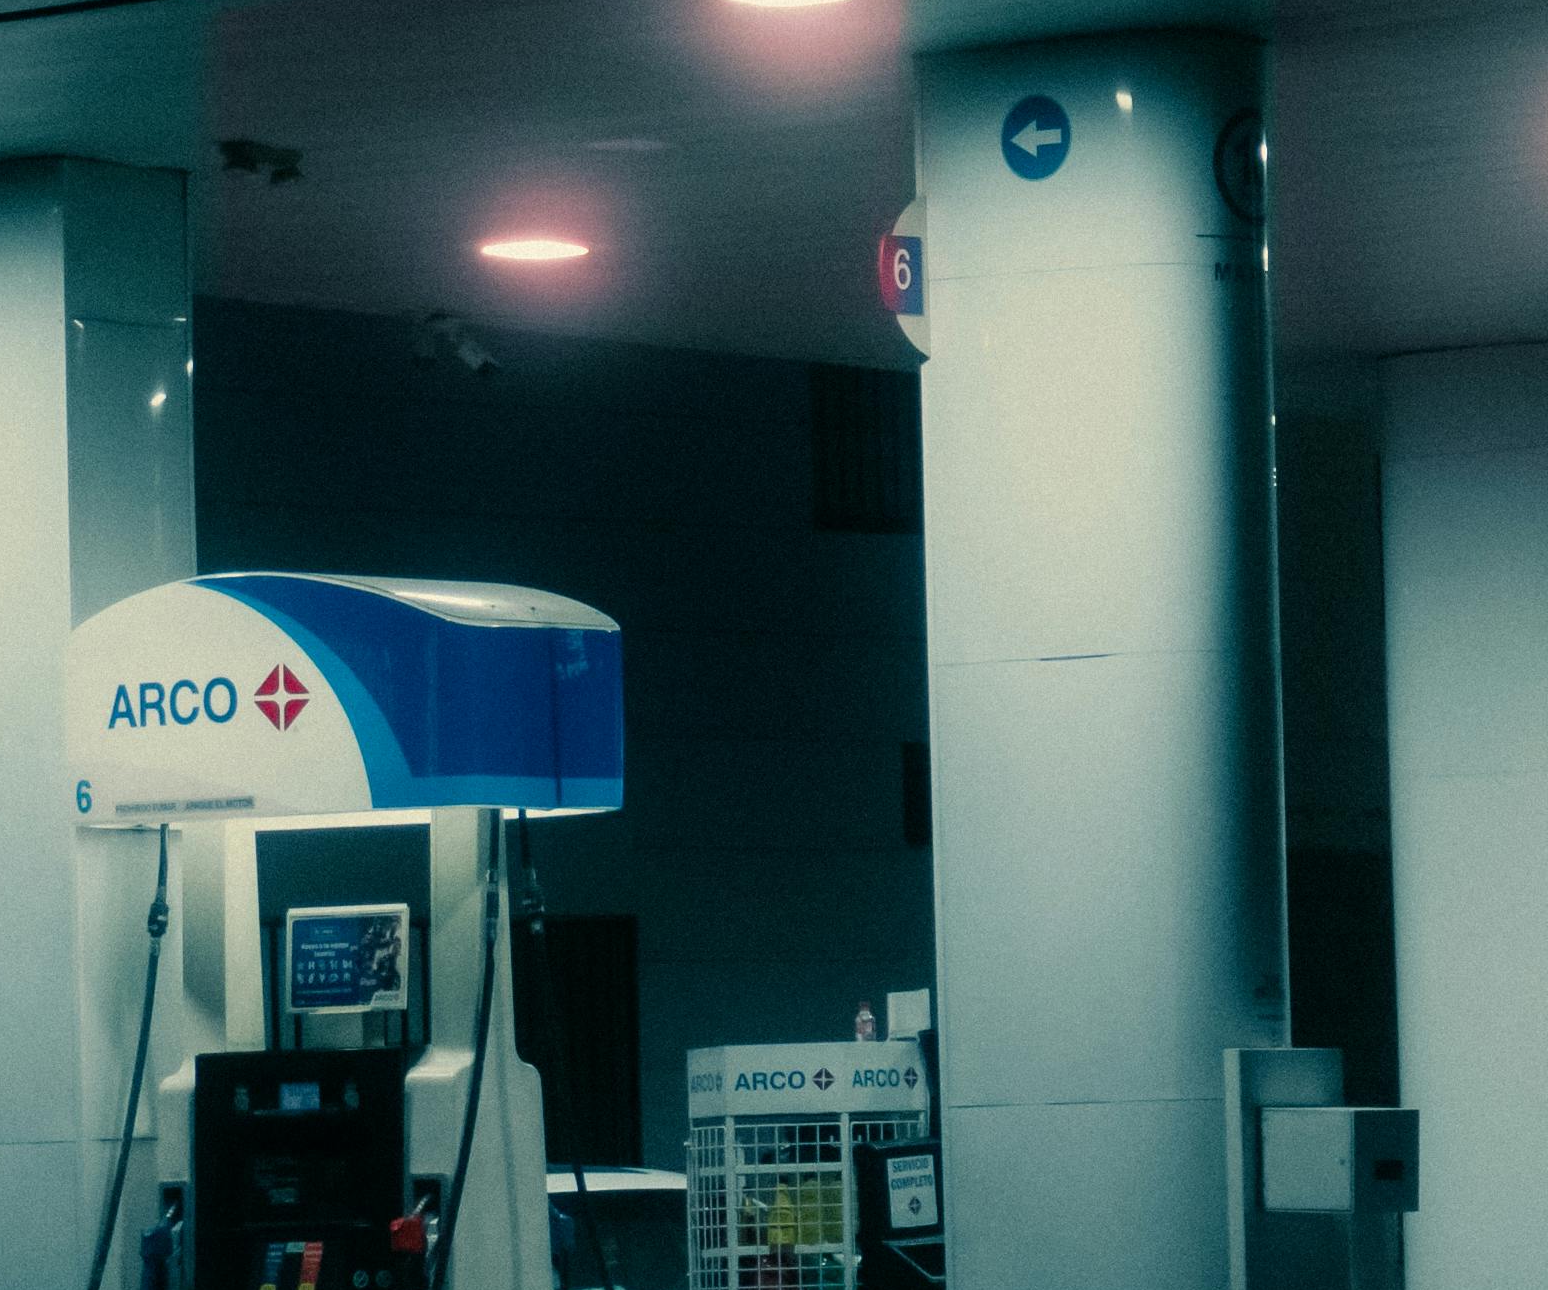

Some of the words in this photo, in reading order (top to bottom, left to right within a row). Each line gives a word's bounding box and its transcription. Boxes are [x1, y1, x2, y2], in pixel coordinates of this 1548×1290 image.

[892, 248, 912, 290] 6
[107, 677, 238, 729] ARCO
[76, 779, 93, 815] 6
[735, 1071, 807, 1092] ARCO
[852, 1068, 901, 1089] ARCO
[891, 1174, 934, 1190] COMPLETO
